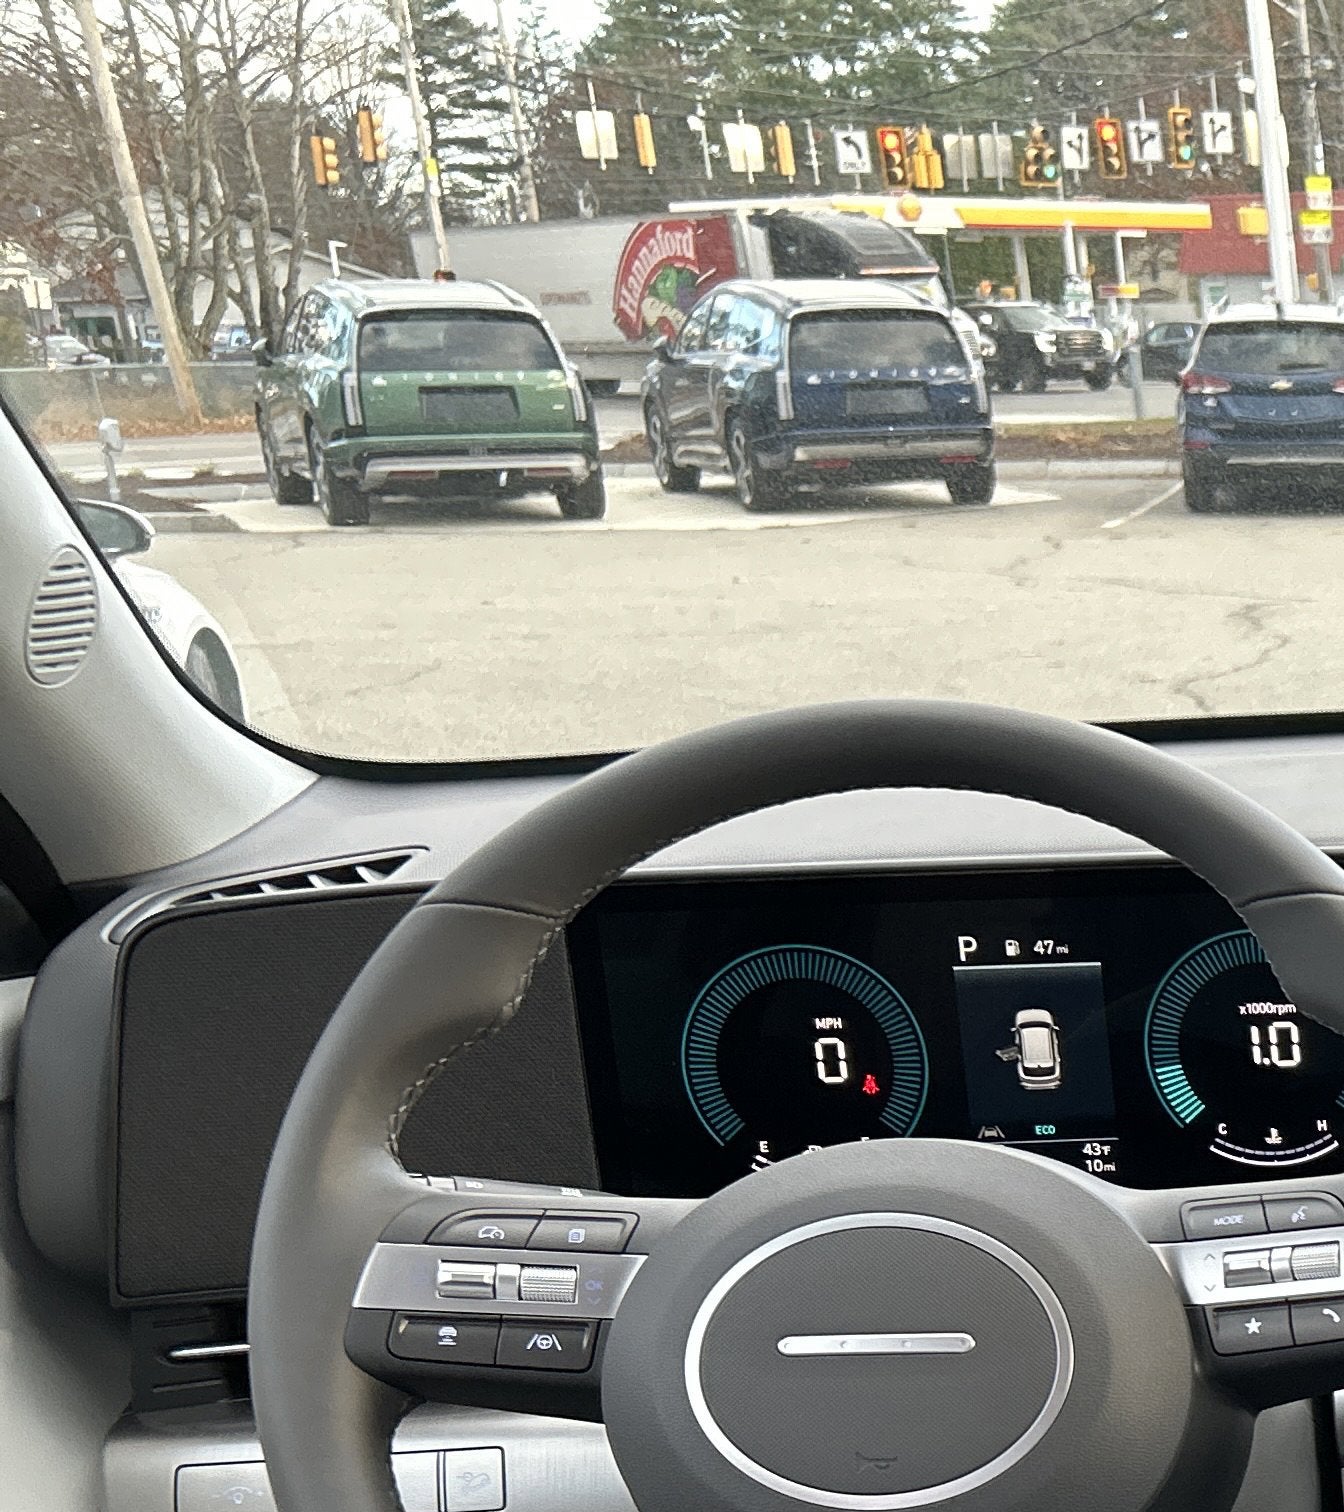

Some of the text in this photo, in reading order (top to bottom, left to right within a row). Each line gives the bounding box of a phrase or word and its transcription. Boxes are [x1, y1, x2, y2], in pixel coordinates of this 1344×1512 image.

[618, 224, 697, 323] Hannaford
[957, 935, 978, 962] P
[1033, 940, 1054, 955] 47
[1239, 1002, 1297, 1015] x1000rpm
[815, 1017, 843, 1030] MPH
[1250, 1021, 1301, 1068] 1.0
[814, 1037, 848, 1084] 0
[1035, 1125, 1056, 1135] ECO
[1217, 1123, 1227, 1135] C
[1317, 1119, 1328, 1131] H
[759, 1141, 769, 1153] E
[1213, 1214, 1244, 1226] MODE
